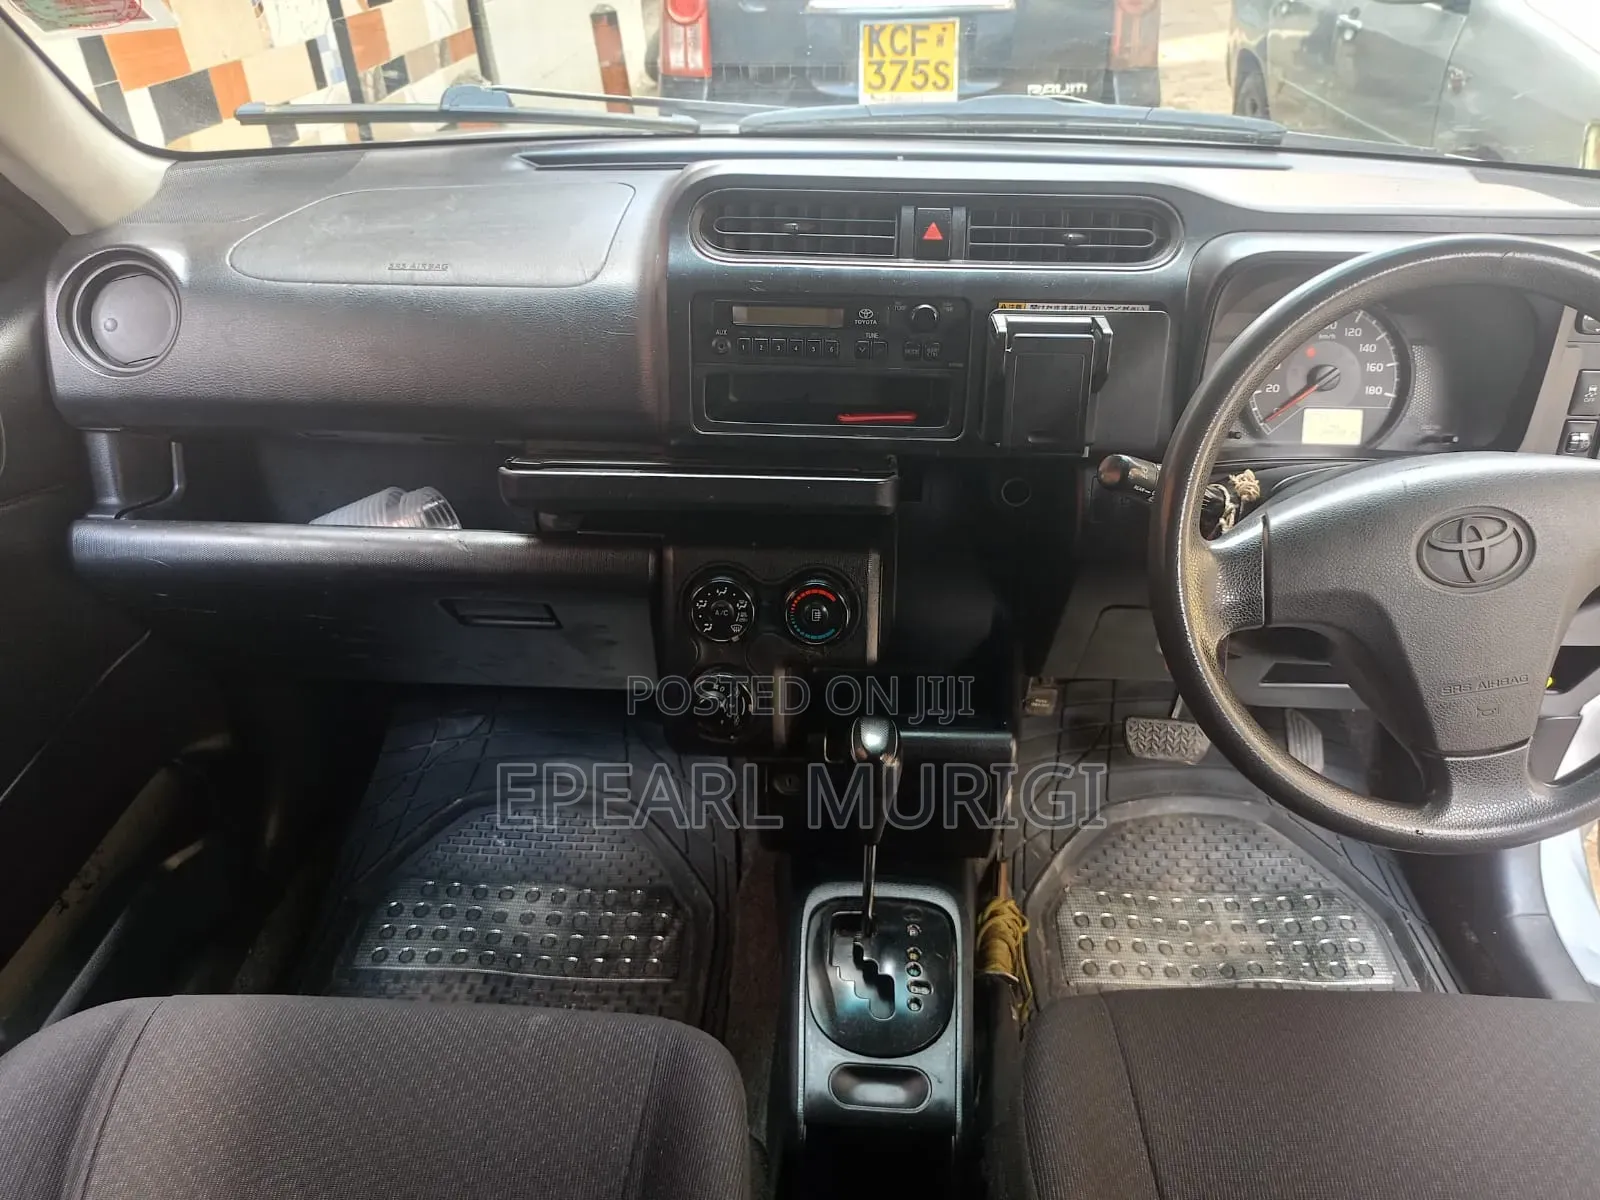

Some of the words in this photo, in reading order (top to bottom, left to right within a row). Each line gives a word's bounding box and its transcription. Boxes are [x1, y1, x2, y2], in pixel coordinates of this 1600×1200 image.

[868, 24, 930, 57] KCF
[868, 60, 950, 92] 375S
[1344, 327, 1362, 337] 120
[1359, 343, 1377, 353] 140
[1366, 362, 1384, 372] 160
[1265, 384, 1280, 393] 20
[1365, 386, 1383, 395] 180
[1441, 682, 1473, 696] SRS
[1476, 674, 1529, 691] AIRBAG
